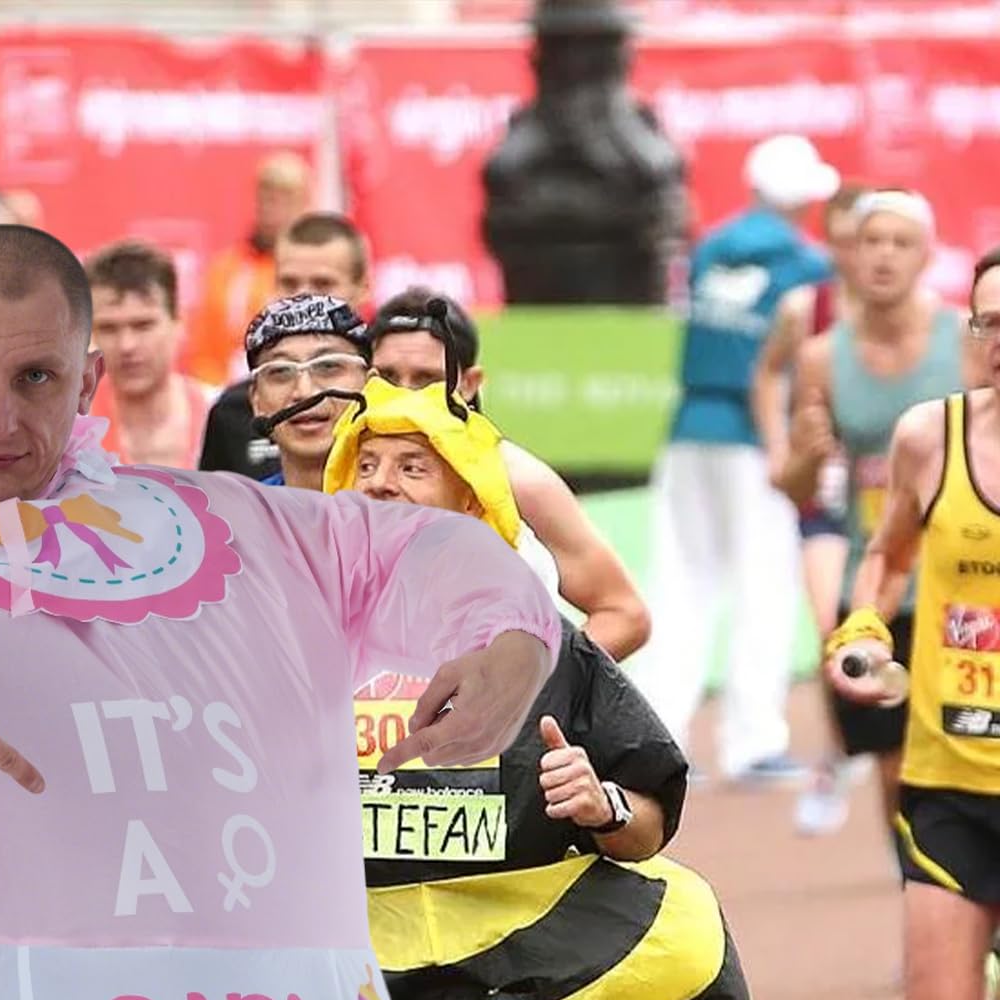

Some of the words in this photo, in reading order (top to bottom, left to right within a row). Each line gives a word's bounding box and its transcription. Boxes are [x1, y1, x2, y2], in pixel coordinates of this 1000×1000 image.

[957, 660, 994, 697] 31
[70, 696, 258, 794] IT'S
[113, 819, 194, 917] A
